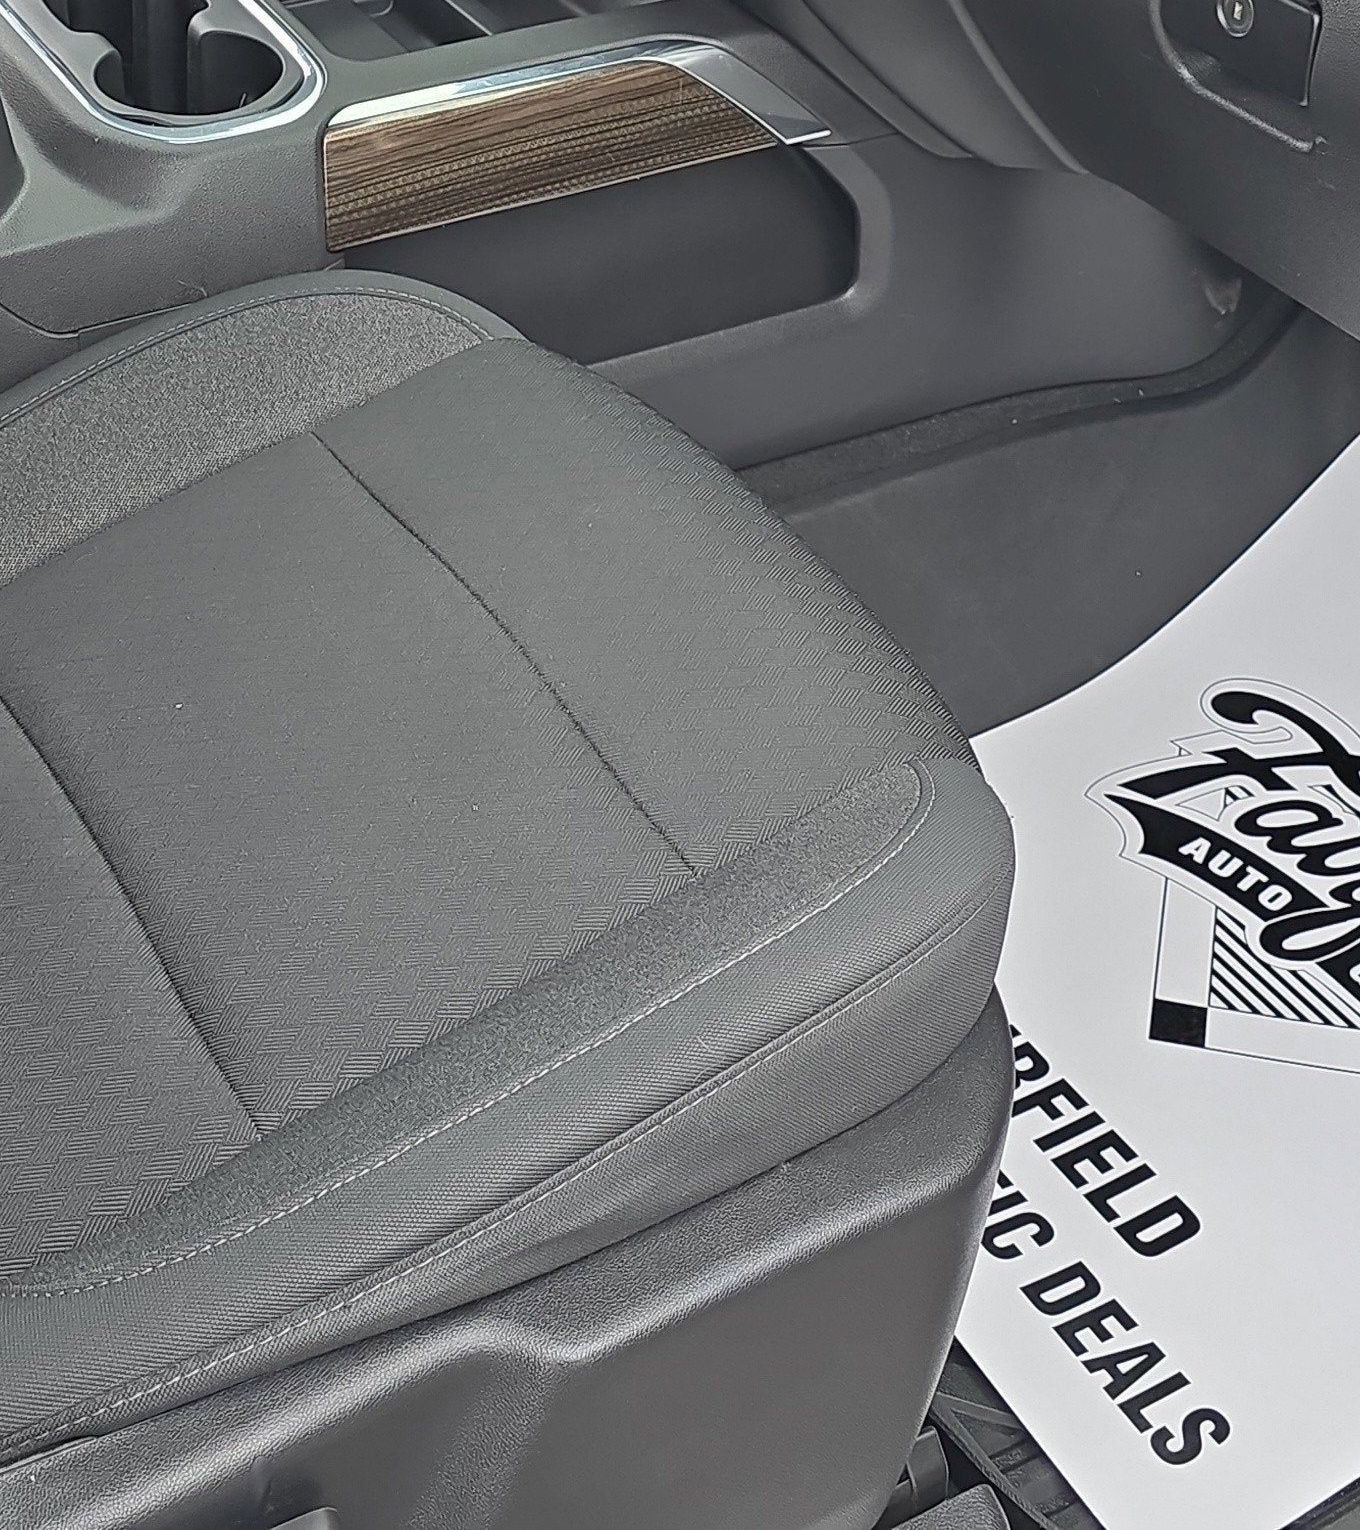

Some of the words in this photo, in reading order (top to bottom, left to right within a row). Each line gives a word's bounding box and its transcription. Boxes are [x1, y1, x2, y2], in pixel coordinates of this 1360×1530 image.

[1178, 837, 1295, 912] AUTO
[1009, 1024, 1202, 1258] RFIELD
[1020, 1260, 1233, 1467] DEALS
